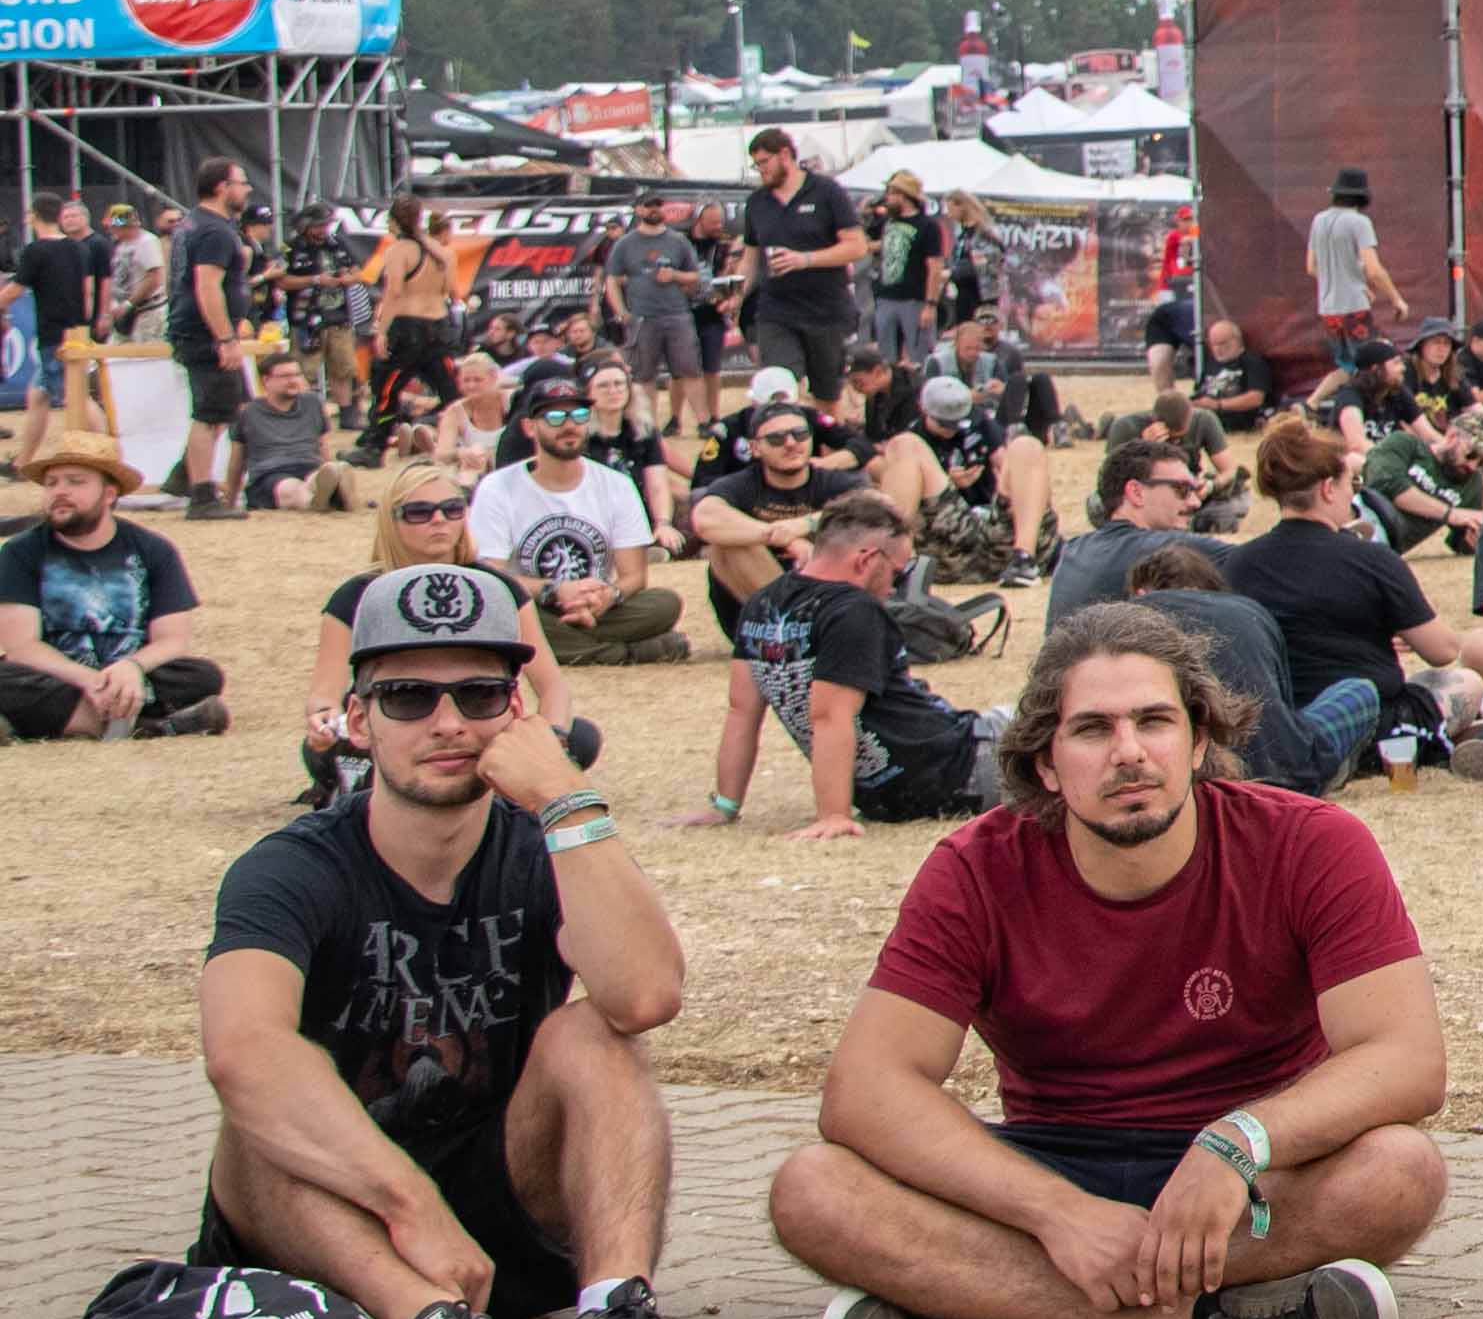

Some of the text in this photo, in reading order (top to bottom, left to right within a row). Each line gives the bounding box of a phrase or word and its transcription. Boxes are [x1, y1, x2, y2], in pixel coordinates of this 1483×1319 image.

[998, 222, 1090, 251] YNAZTY
[521, 516, 607, 557] SUMMER BREEZE
